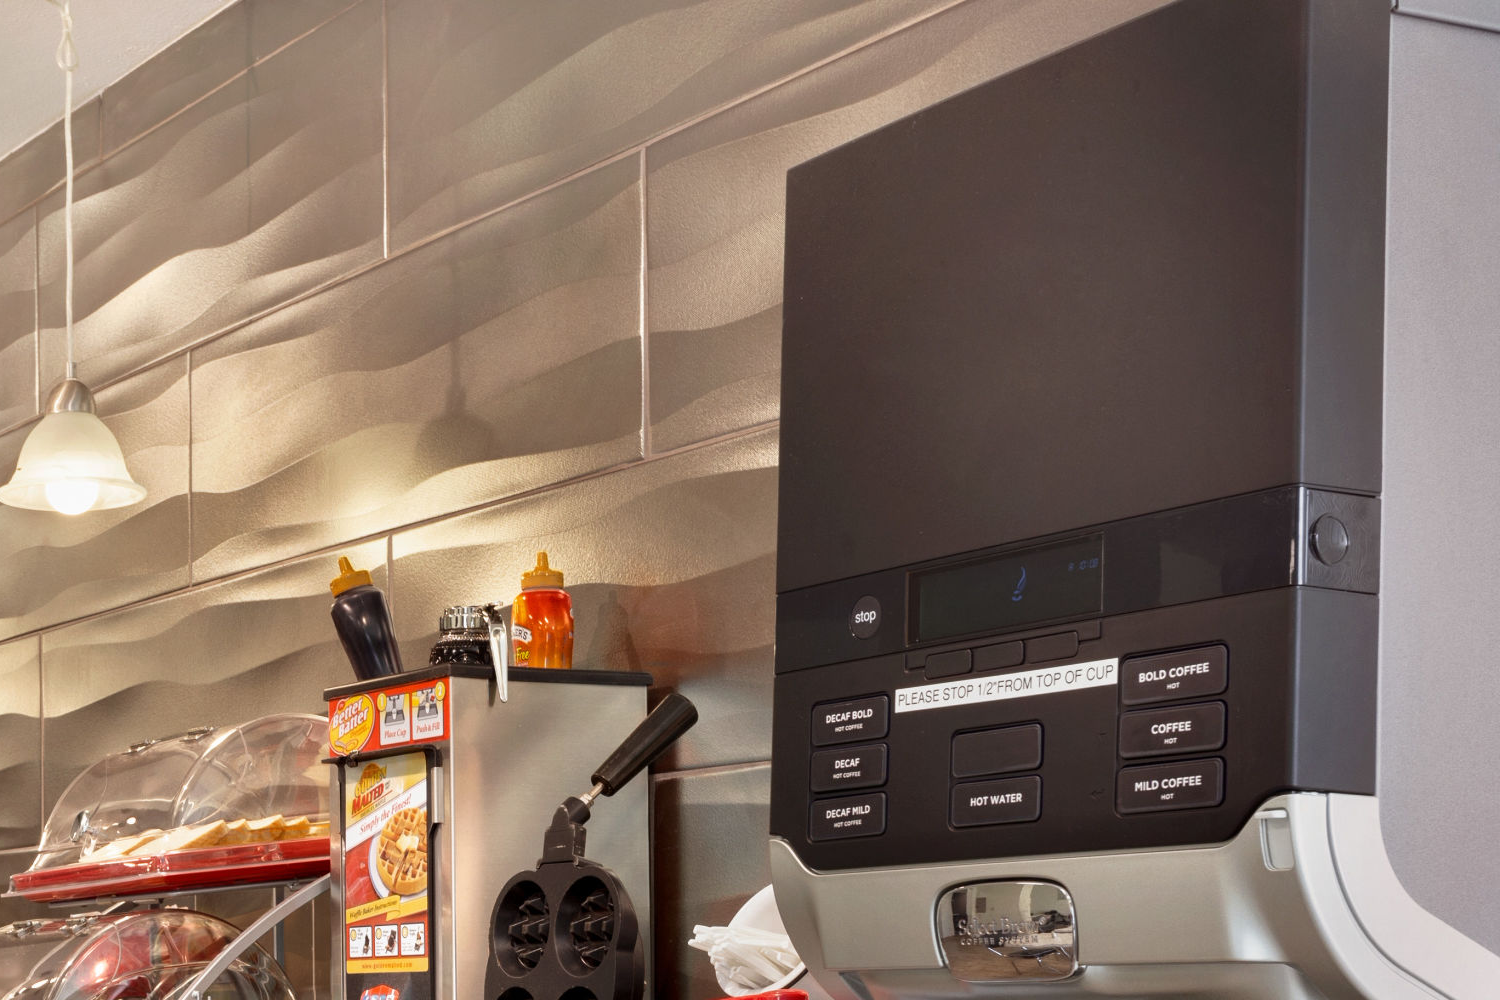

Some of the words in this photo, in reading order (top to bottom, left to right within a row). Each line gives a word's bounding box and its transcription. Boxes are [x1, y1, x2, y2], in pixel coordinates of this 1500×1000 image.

[855, 611, 876, 623] stop
[1139, 670, 1166, 683] BOLD
[1169, 662, 1210, 678] COFFEE
[898, 690, 940, 706] PLEASE
[942, 685, 974, 700] STOP
[1037, 672, 1061, 688] TOP
[1065, 669, 1082, 684] OF
[1087, 664, 1113, 681] CUP
[332, 699, 363, 729] Better
[826, 712, 851, 724] DECAF
[852, 709, 873, 720] BOLD
[338, 708, 369, 738] Batter
[845, 723, 863, 731] COFFEE
[1151, 721, 1191, 734] COFFEE
[835, 758, 860, 769] DECAF
[1134, 780, 1159, 792] MILD
[1161, 775, 1202, 789] COFFEE
[352, 783, 384, 815] MALTED
[970, 796, 988, 807] HOT
[990, 793, 1022, 804] WATER
[826, 808, 851, 819] DECAF
[852, 805, 870, 815] MILD
[360, 816, 379, 833] Simply
[381, 809, 390, 820] the
[844, 819, 862, 827] COFFEE
[959, 917, 998, 936] Select
[1001, 918, 1039, 933] Brew
[961, 938, 995, 946] COFFEE
[999, 935, 1039, 945] SYSTEM
